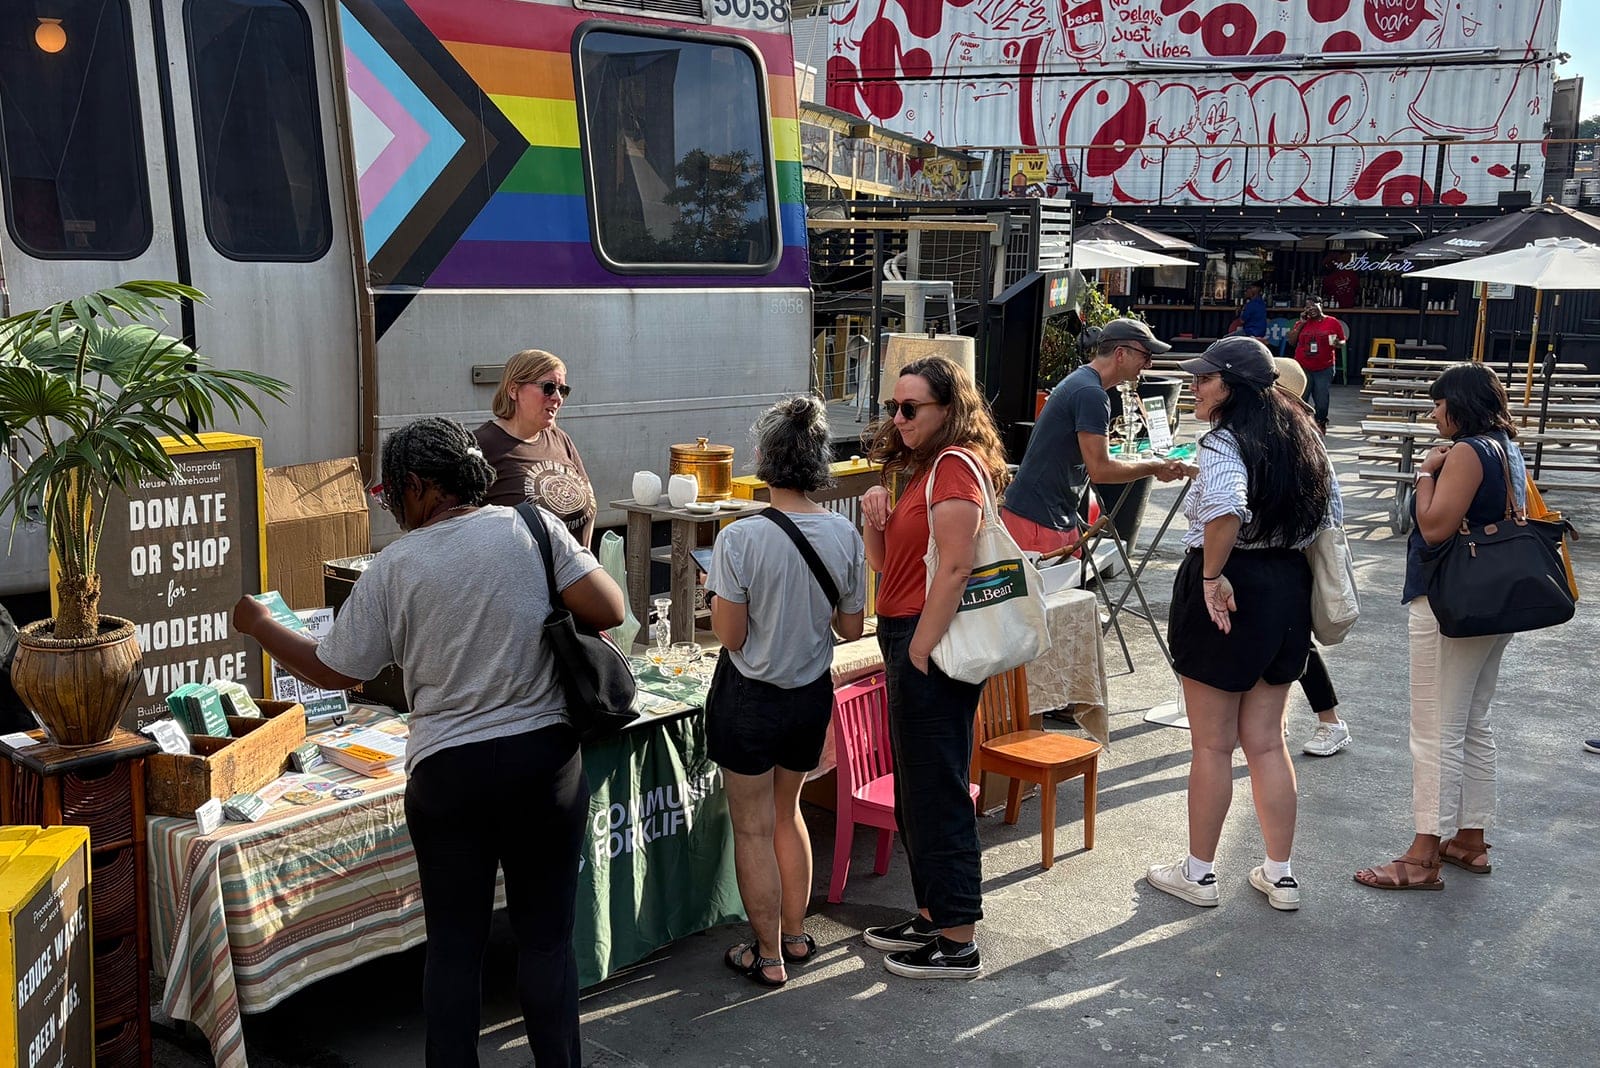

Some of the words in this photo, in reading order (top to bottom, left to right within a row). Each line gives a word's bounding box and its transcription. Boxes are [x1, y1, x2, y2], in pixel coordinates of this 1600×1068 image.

[1066, 11, 1099, 28] beer
[1119, 5, 1163, 26] Delays
[1111, 25, 1151, 42] Just
[1141, 40, 1192, 58] Vibes
[179, 461, 220, 474] Nonprofit
[139, 480, 166, 489] Reuse
[129, 493, 227, 531] DONATE
[130, 544, 161, 576] OR
[172, 536, 230, 571] SHOP
[136, 611, 228, 652] MODERN
[143, 651, 247, 697] VINTAGE
[137, 703, 170, 717] Buildin
[18, 944, 52, 1010] REDUCE
[29, 1012, 56, 1068] GREEN
